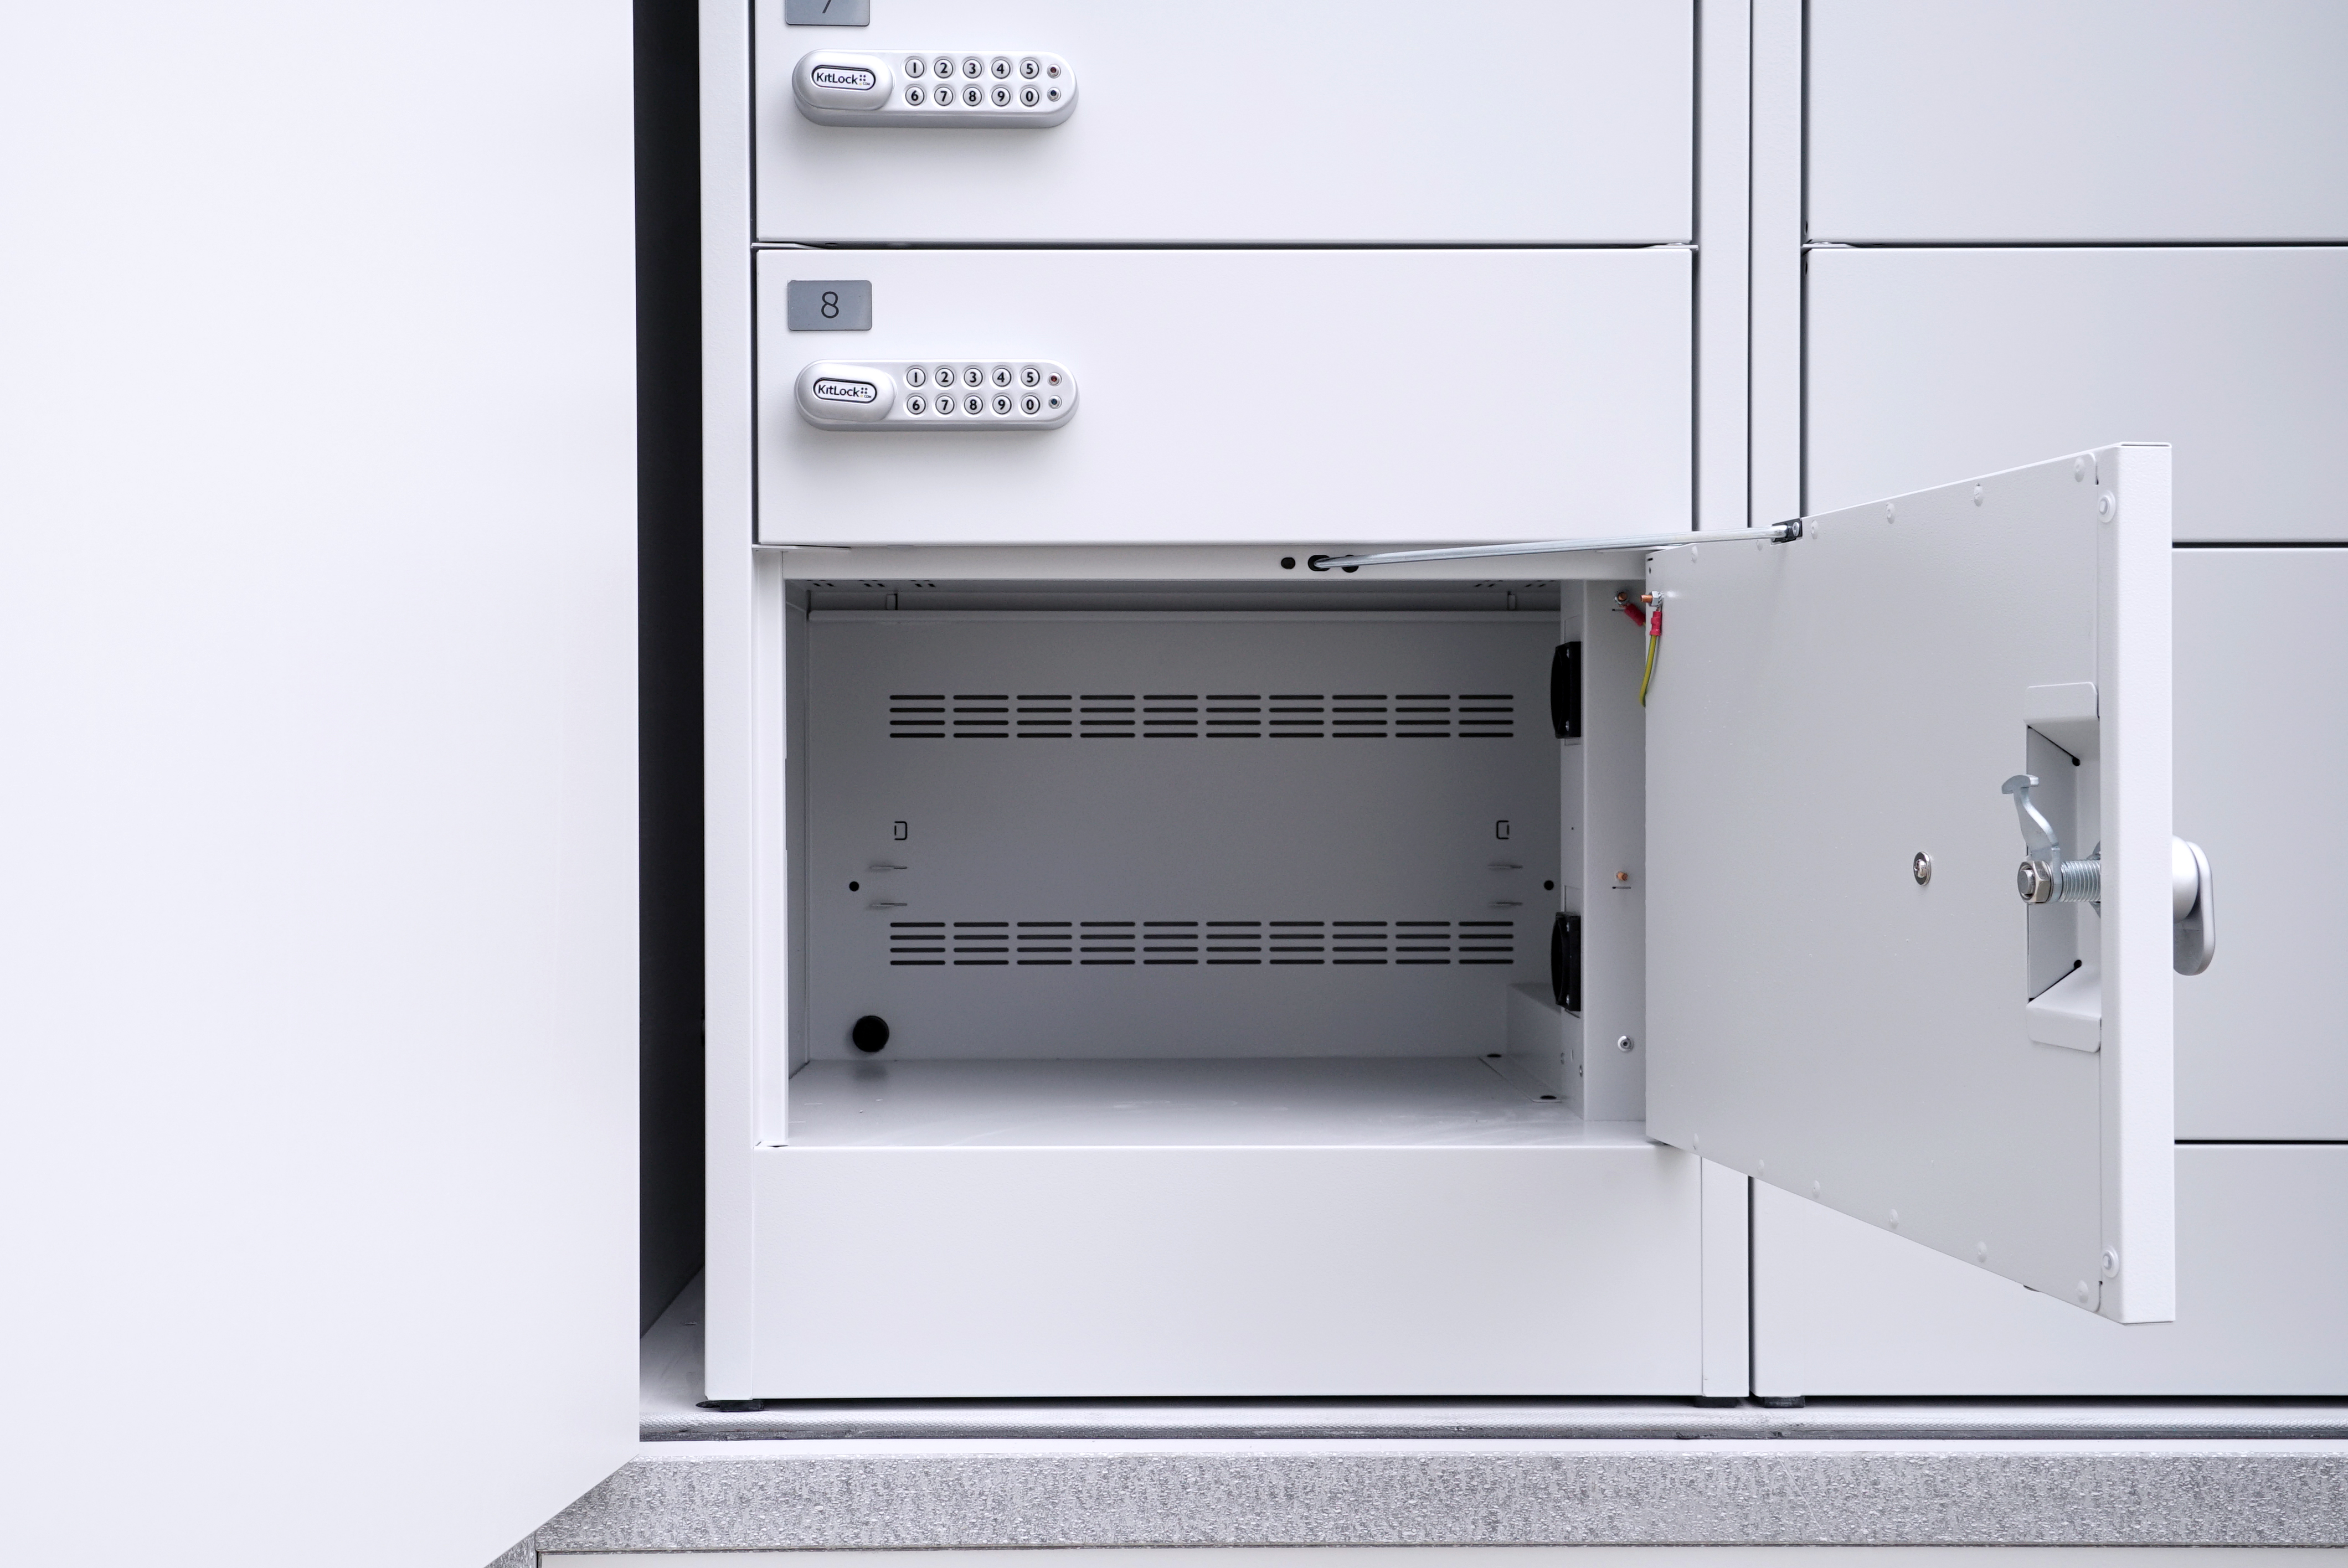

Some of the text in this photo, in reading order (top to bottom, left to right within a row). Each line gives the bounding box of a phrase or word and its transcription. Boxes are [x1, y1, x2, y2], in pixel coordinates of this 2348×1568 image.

[940, 62, 948, 74] 2
[969, 63, 976, 75] 3
[996, 63, 1005, 74] 4
[1026, 63, 1033, 75] 5
[816, 72, 858, 85] KitLock
[910, 90, 1034, 102] 6 7 8 9 0
[821, 291, 839, 319] 8
[941, 371, 949, 383] 2
[969, 372, 977, 383] 3
[997, 372, 1005, 383] 4
[1026, 372, 1034, 383] 5
[818, 384, 860, 397] KitLock
[912, 399, 1034, 411] 6 7 8 9 0
